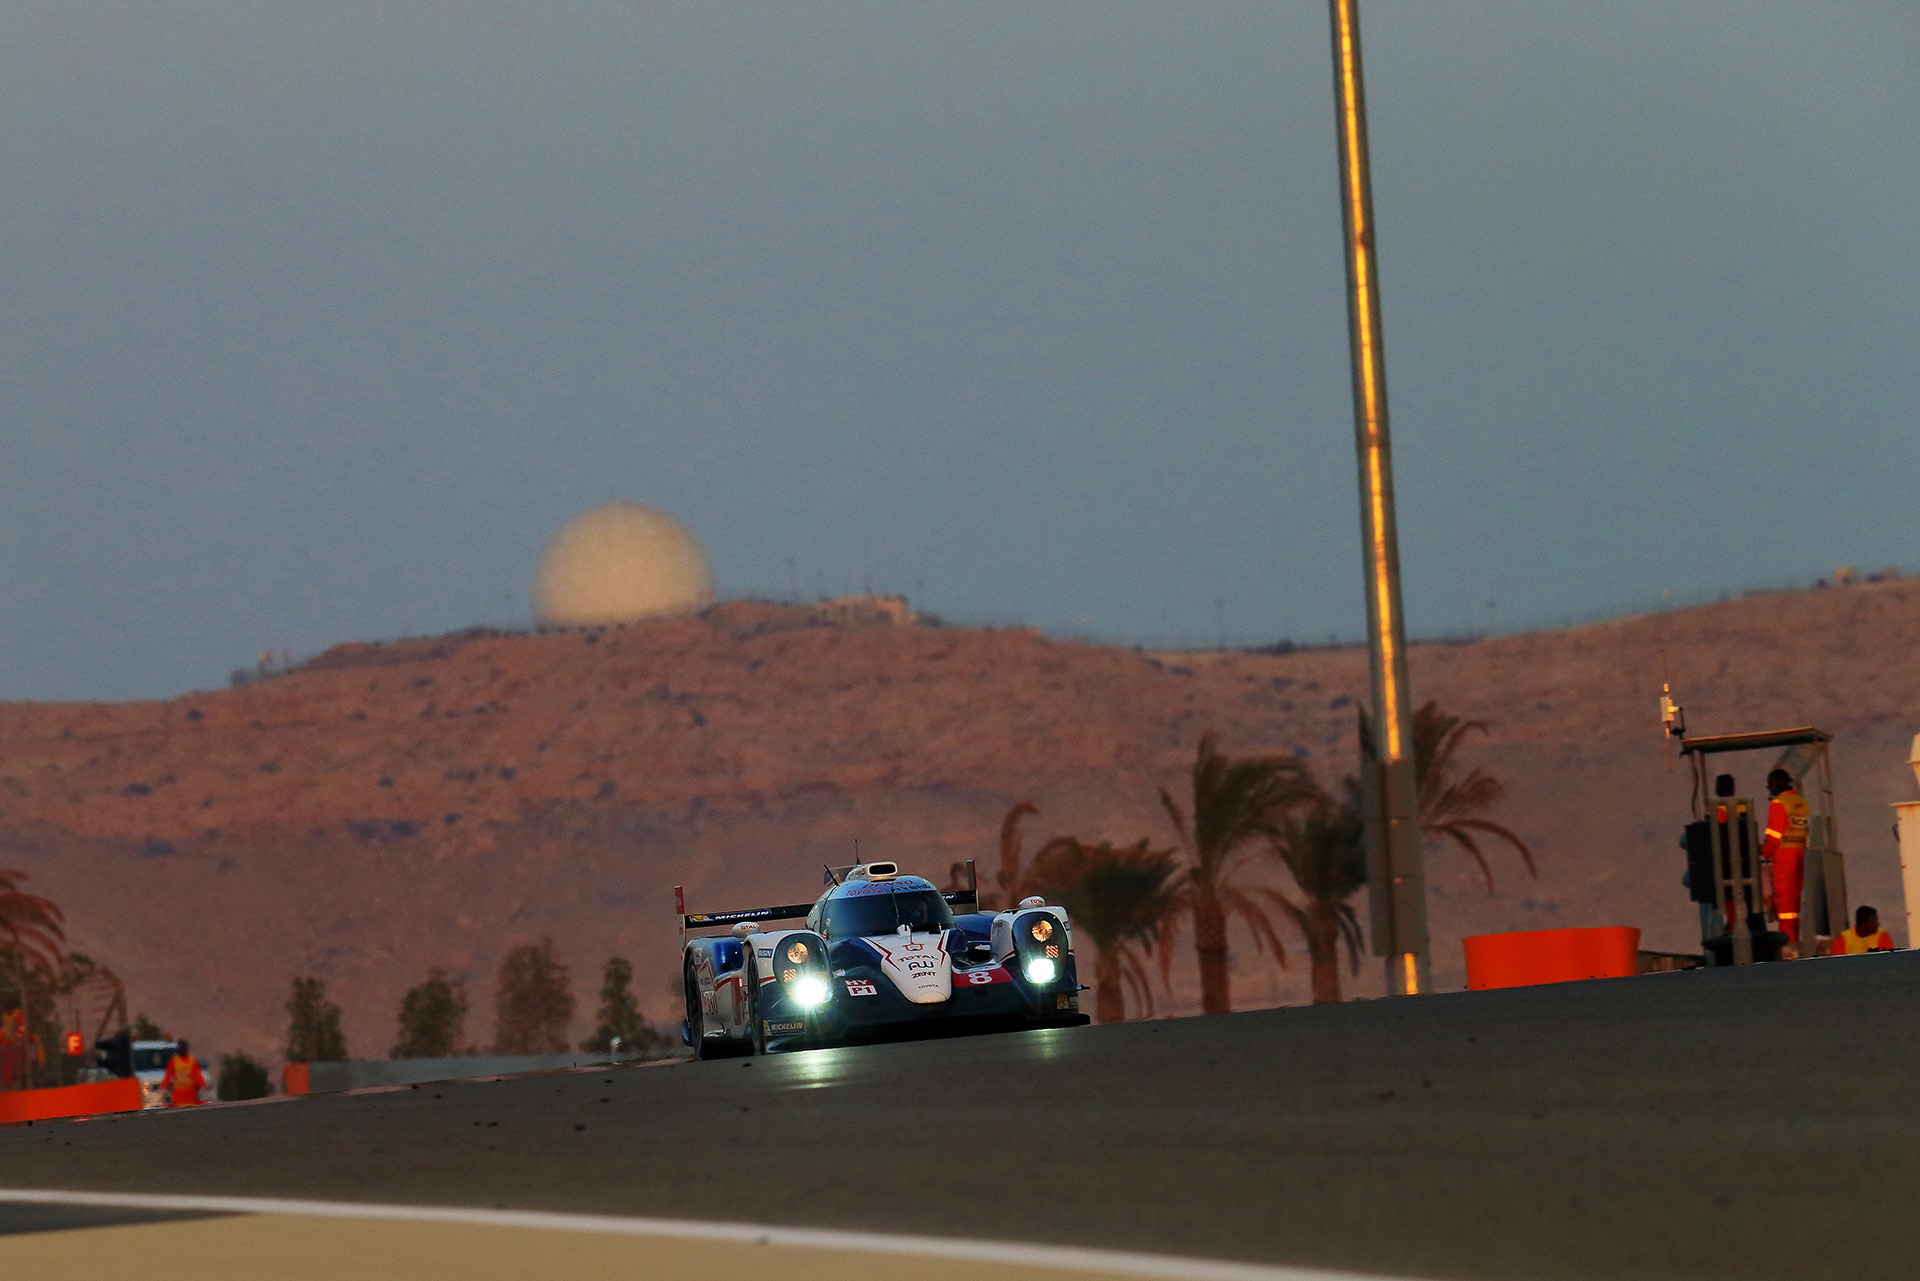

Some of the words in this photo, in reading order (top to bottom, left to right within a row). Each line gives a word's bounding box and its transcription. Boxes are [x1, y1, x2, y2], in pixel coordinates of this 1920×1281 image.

[862, 879, 914, 889] DENSO
[846, 888, 885, 897] TOYOTA
[714, 910, 770, 920] MICHELIN
[898, 954, 939, 963] TOTAL
[911, 971, 938, 979] ZENT
[968, 971, 993, 985] 8
[852, 986, 872, 994] P1
[770, 1021, 803, 1031] MICHELIN
